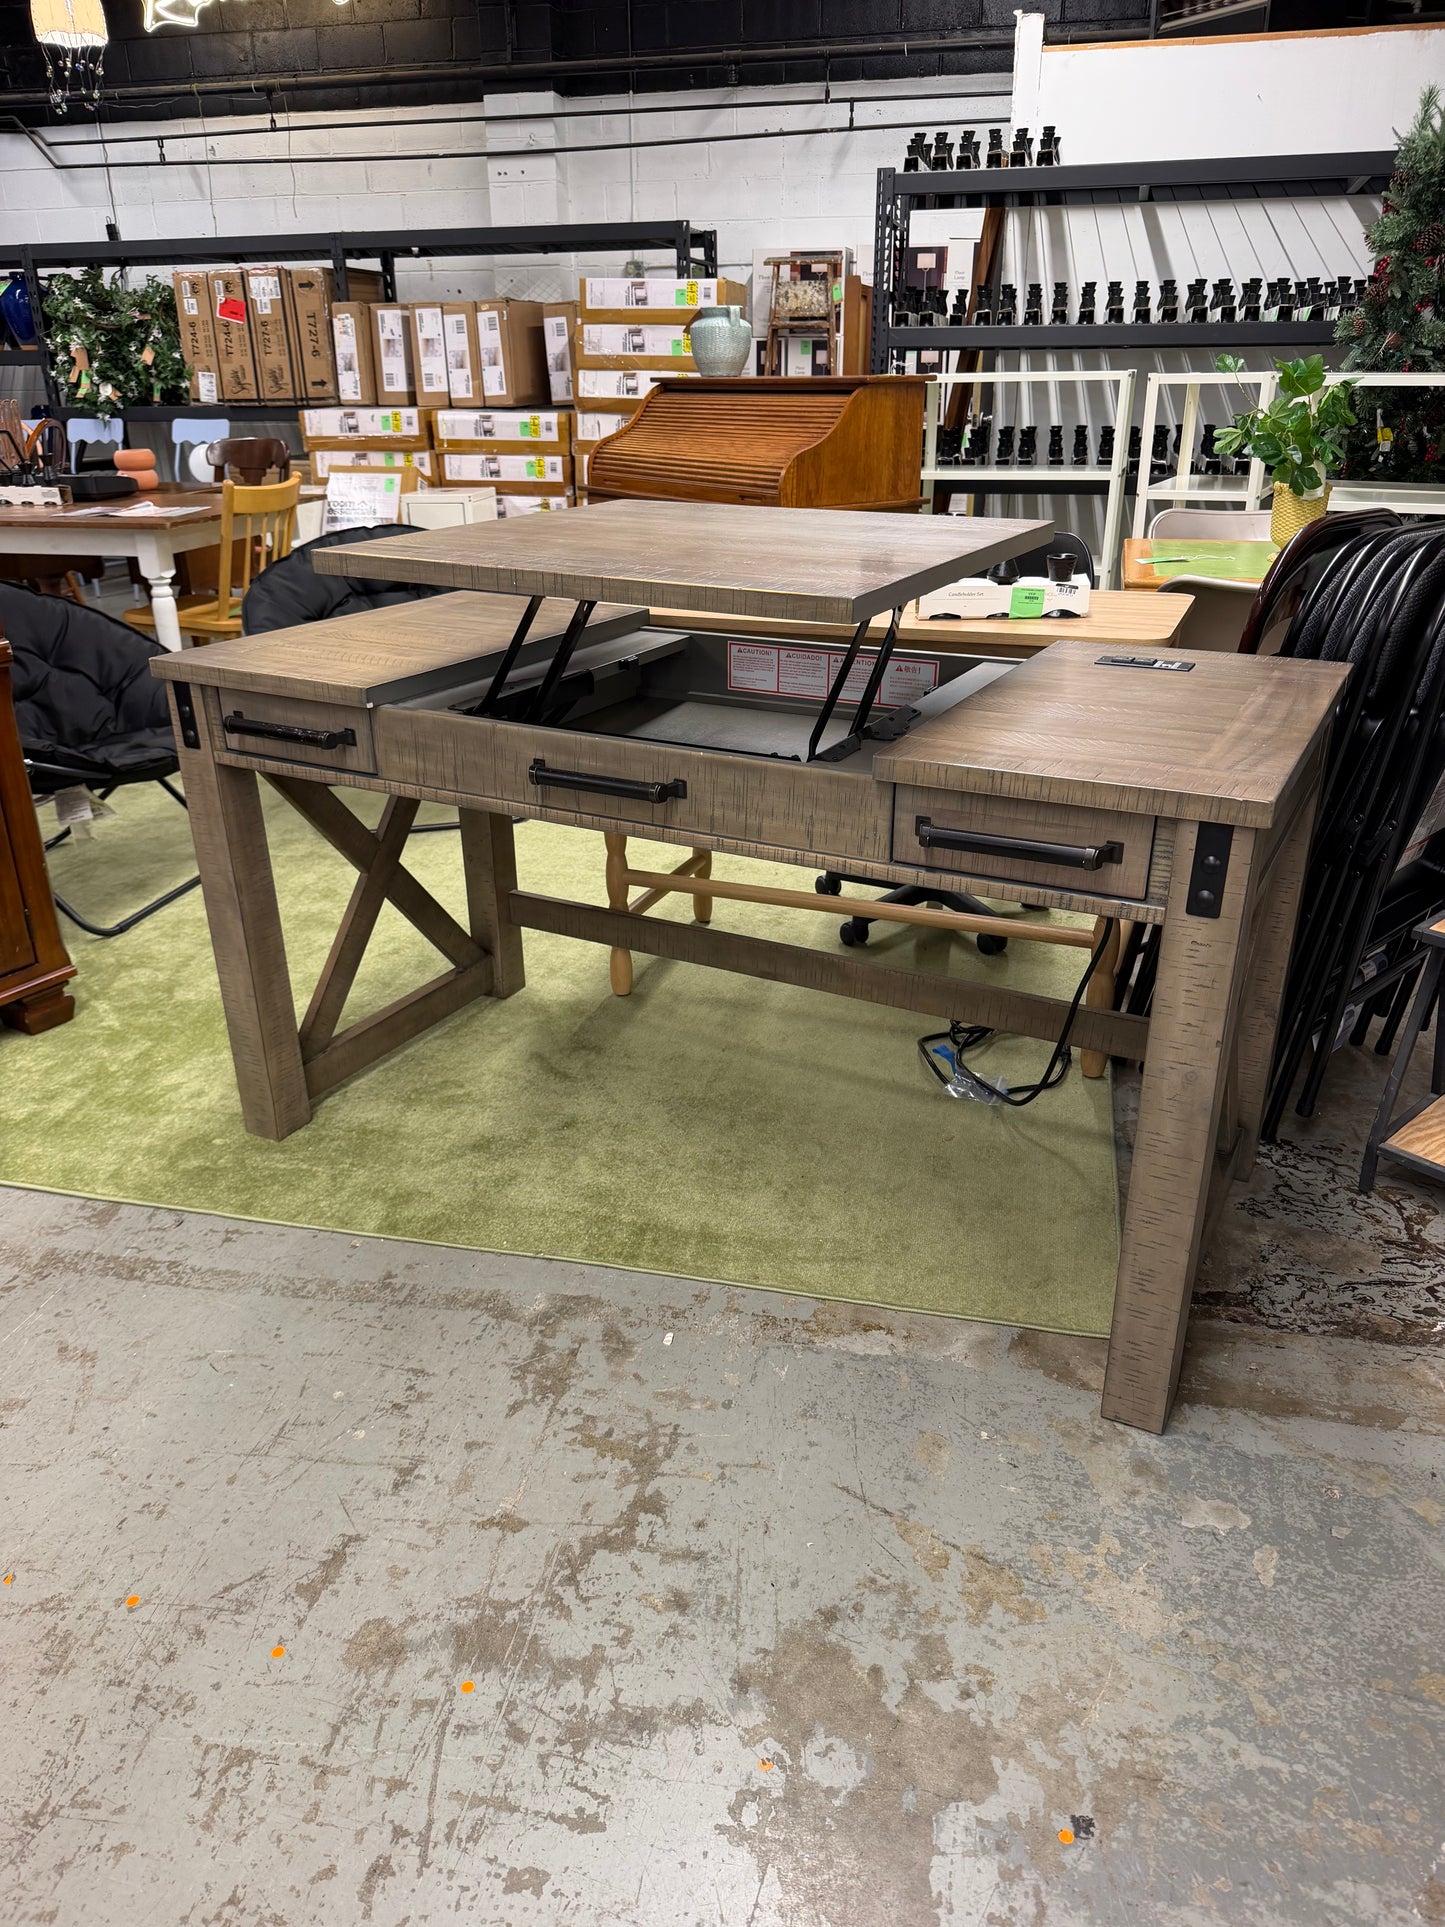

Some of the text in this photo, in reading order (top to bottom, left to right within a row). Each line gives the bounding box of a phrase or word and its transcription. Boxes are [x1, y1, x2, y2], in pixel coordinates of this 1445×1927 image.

[188, 321, 200, 356] T724-6
[223, 320, 235, 357] T724-6
[261, 320, 273, 356] T727-6
[306, 312, 321, 357] T727-6
[742, 648, 772, 656] CAUTION!
[792, 653, 823, 661] CUIDADO!
